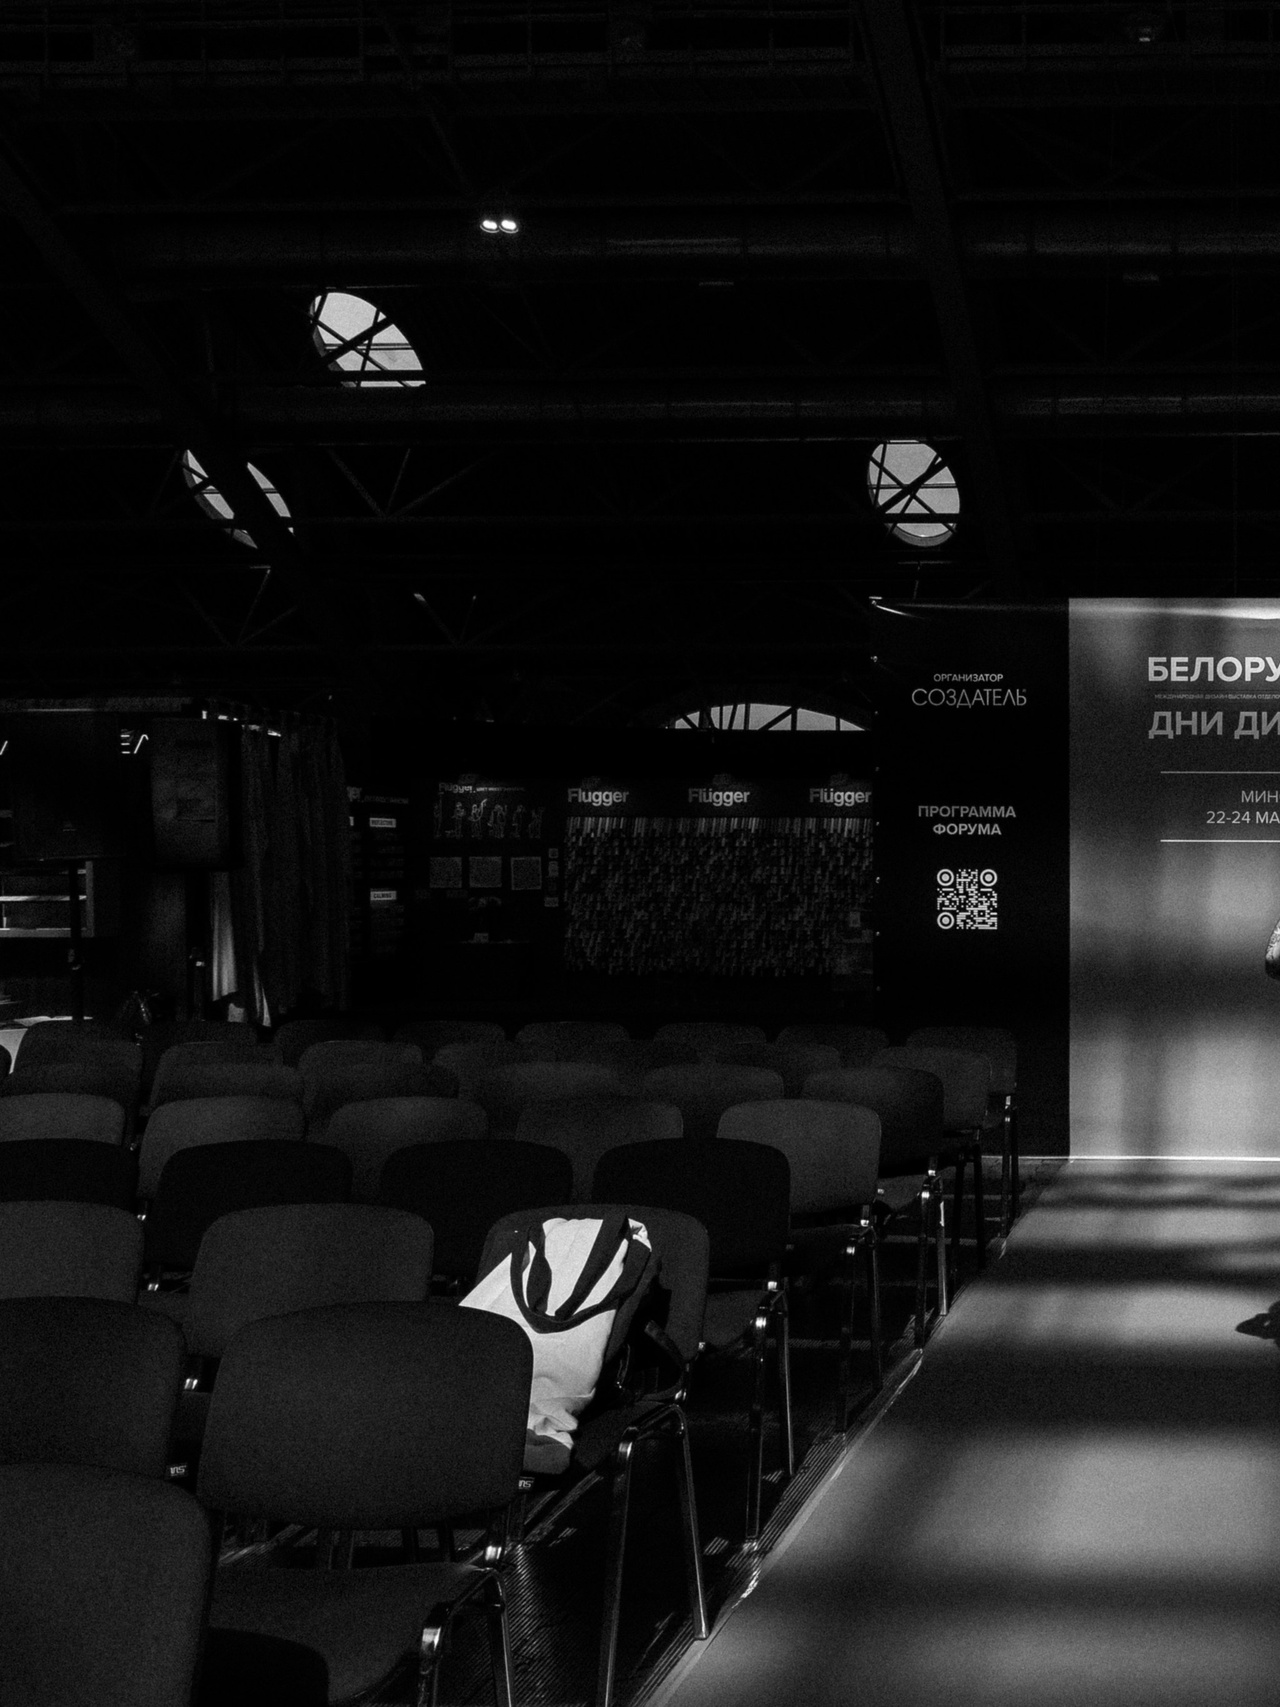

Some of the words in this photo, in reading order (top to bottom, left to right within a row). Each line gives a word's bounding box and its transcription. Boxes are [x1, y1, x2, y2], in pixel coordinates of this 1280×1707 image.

[933, 673, 1004, 682] ОРГАНИЗАТОР
[911, 688, 1028, 709] СОЗДАТЕЛЬ
[1148, 711, 1224, 739] ДНИ
[688, 787, 751, 807] Flügger
[809, 787, 873, 807] Flügger
[918, 805, 1017, 818] ПРОГРАММА
[1206, 811, 1251, 824] 22-24
[932, 823, 1002, 835] ФОРУМА
